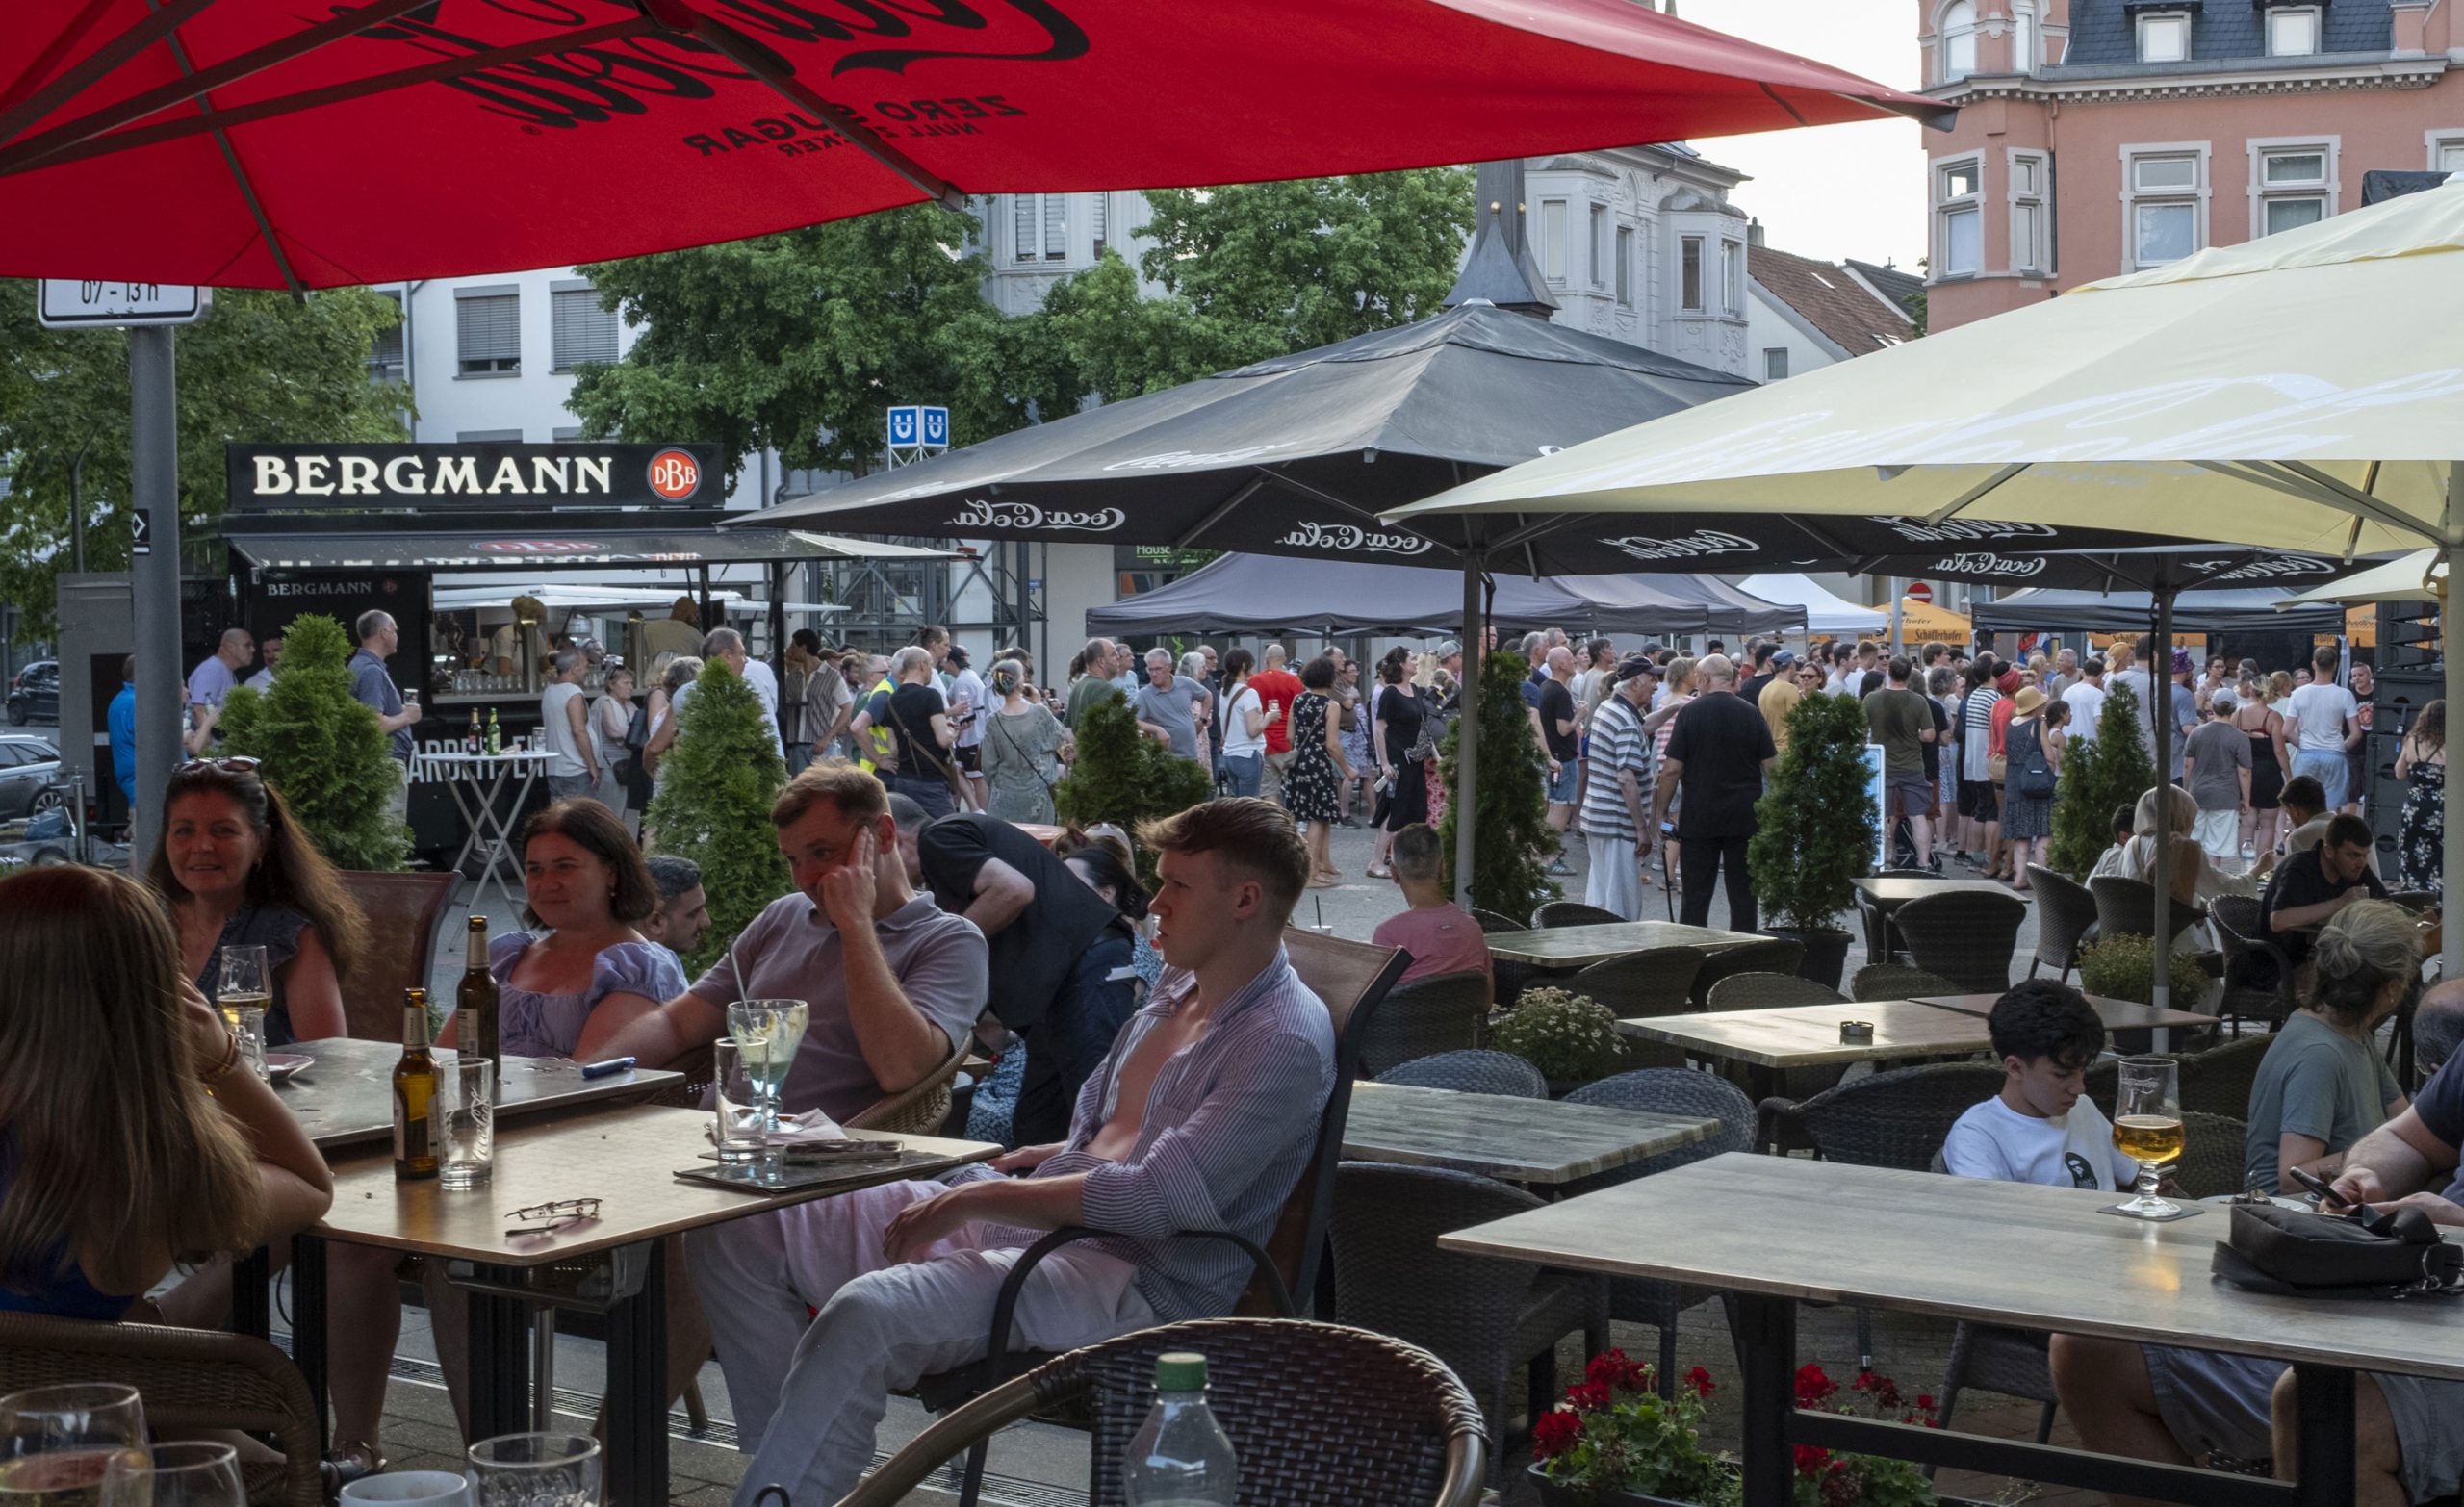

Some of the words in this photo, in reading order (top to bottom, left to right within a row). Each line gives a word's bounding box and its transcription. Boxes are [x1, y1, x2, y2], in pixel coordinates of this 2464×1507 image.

[81, 279, 102, 302] 07
[126, 283, 141, 302] 13
[252, 455, 613, 497] BERGMANN
[654, 459, 697, 491] DBB
[267, 581, 372, 596] BERGMANN
